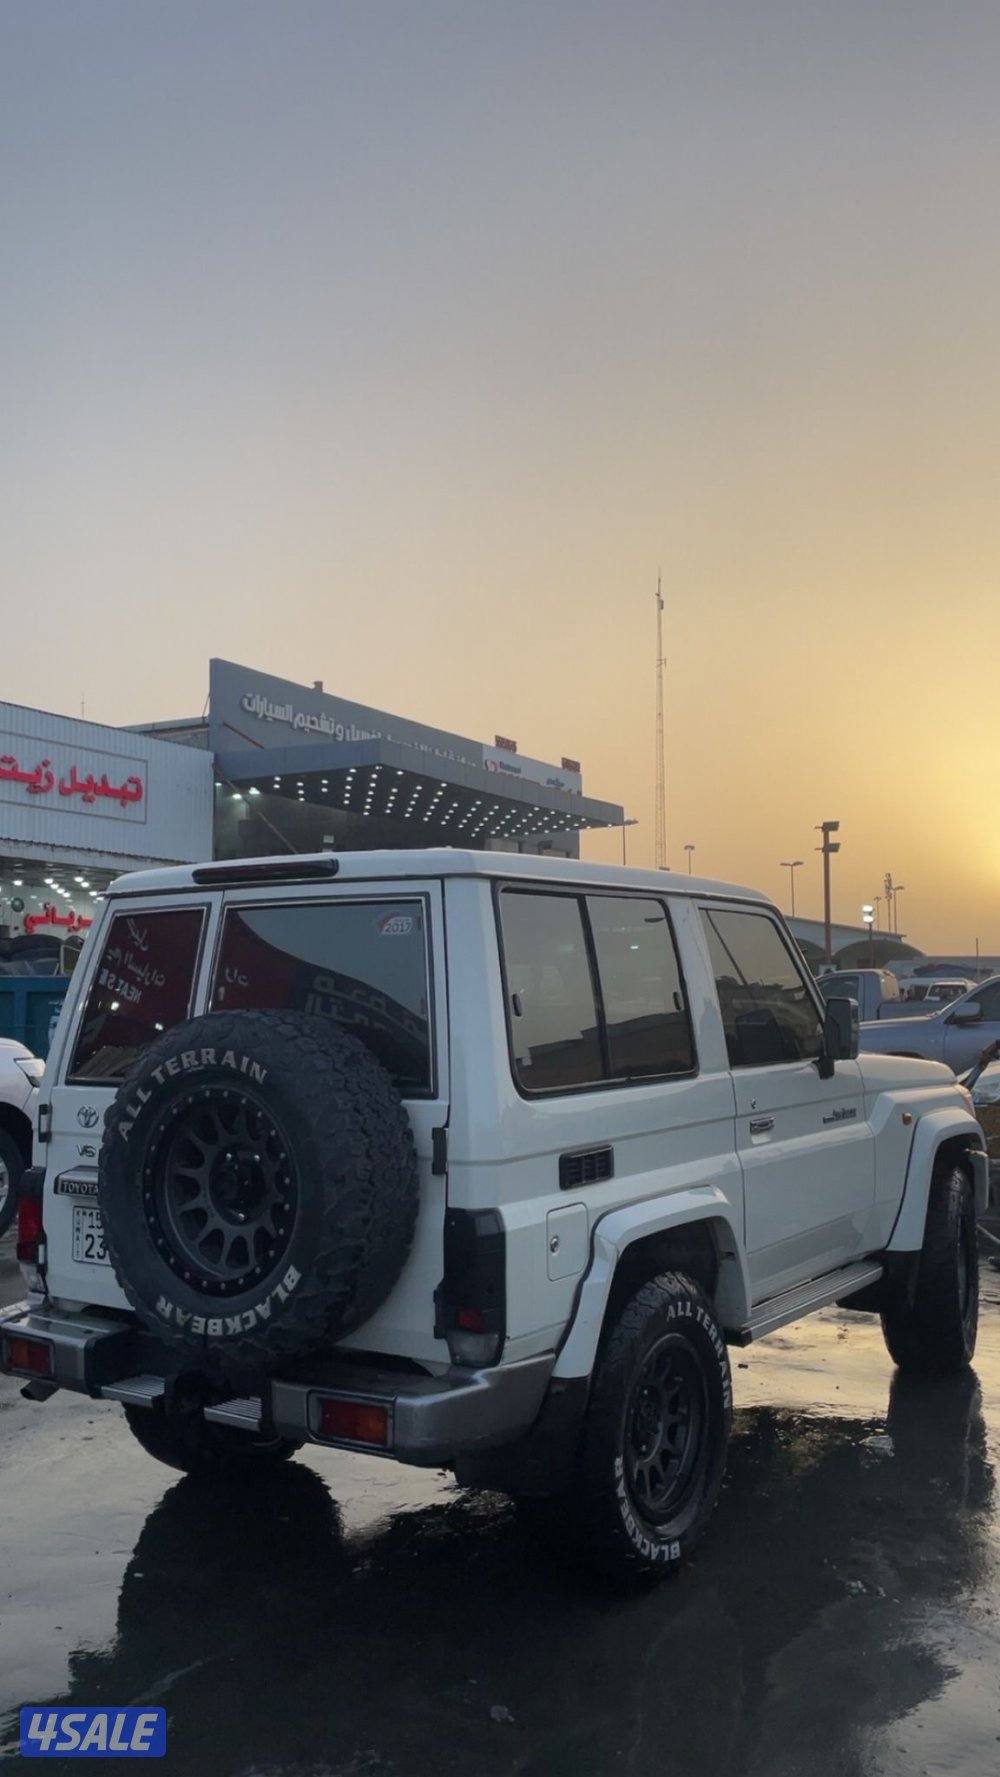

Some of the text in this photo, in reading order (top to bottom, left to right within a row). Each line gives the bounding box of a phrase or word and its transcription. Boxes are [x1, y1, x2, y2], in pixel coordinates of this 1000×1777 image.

[242, 692, 293, 723] السيارات
[0, 754, 144, 808] تبديل زيت
[384, 921, 412, 933] 2017
[117, 1047, 268, 1142] ALL TERRAIN
[62, 1180, 99, 1195] TOYOTA
[155, 1264, 302, 1337] BLACKBEAR
[667, 1301, 693, 1322] ALL
